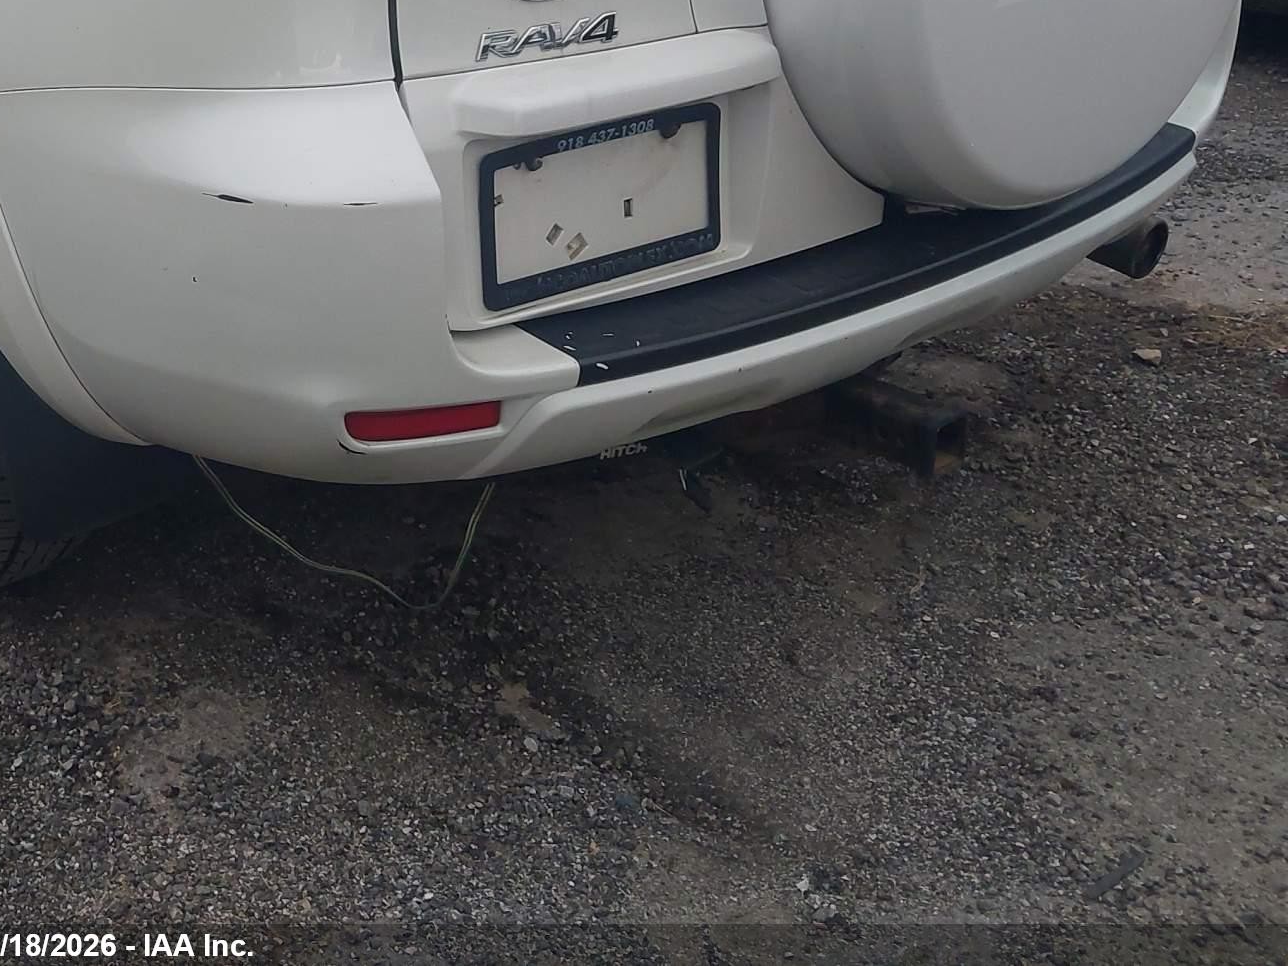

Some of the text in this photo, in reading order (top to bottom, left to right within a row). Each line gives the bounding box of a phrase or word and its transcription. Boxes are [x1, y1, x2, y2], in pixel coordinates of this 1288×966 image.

[476, 11, 619, 62] RAV4
[557, 119, 654, 152] 918 437-1308
